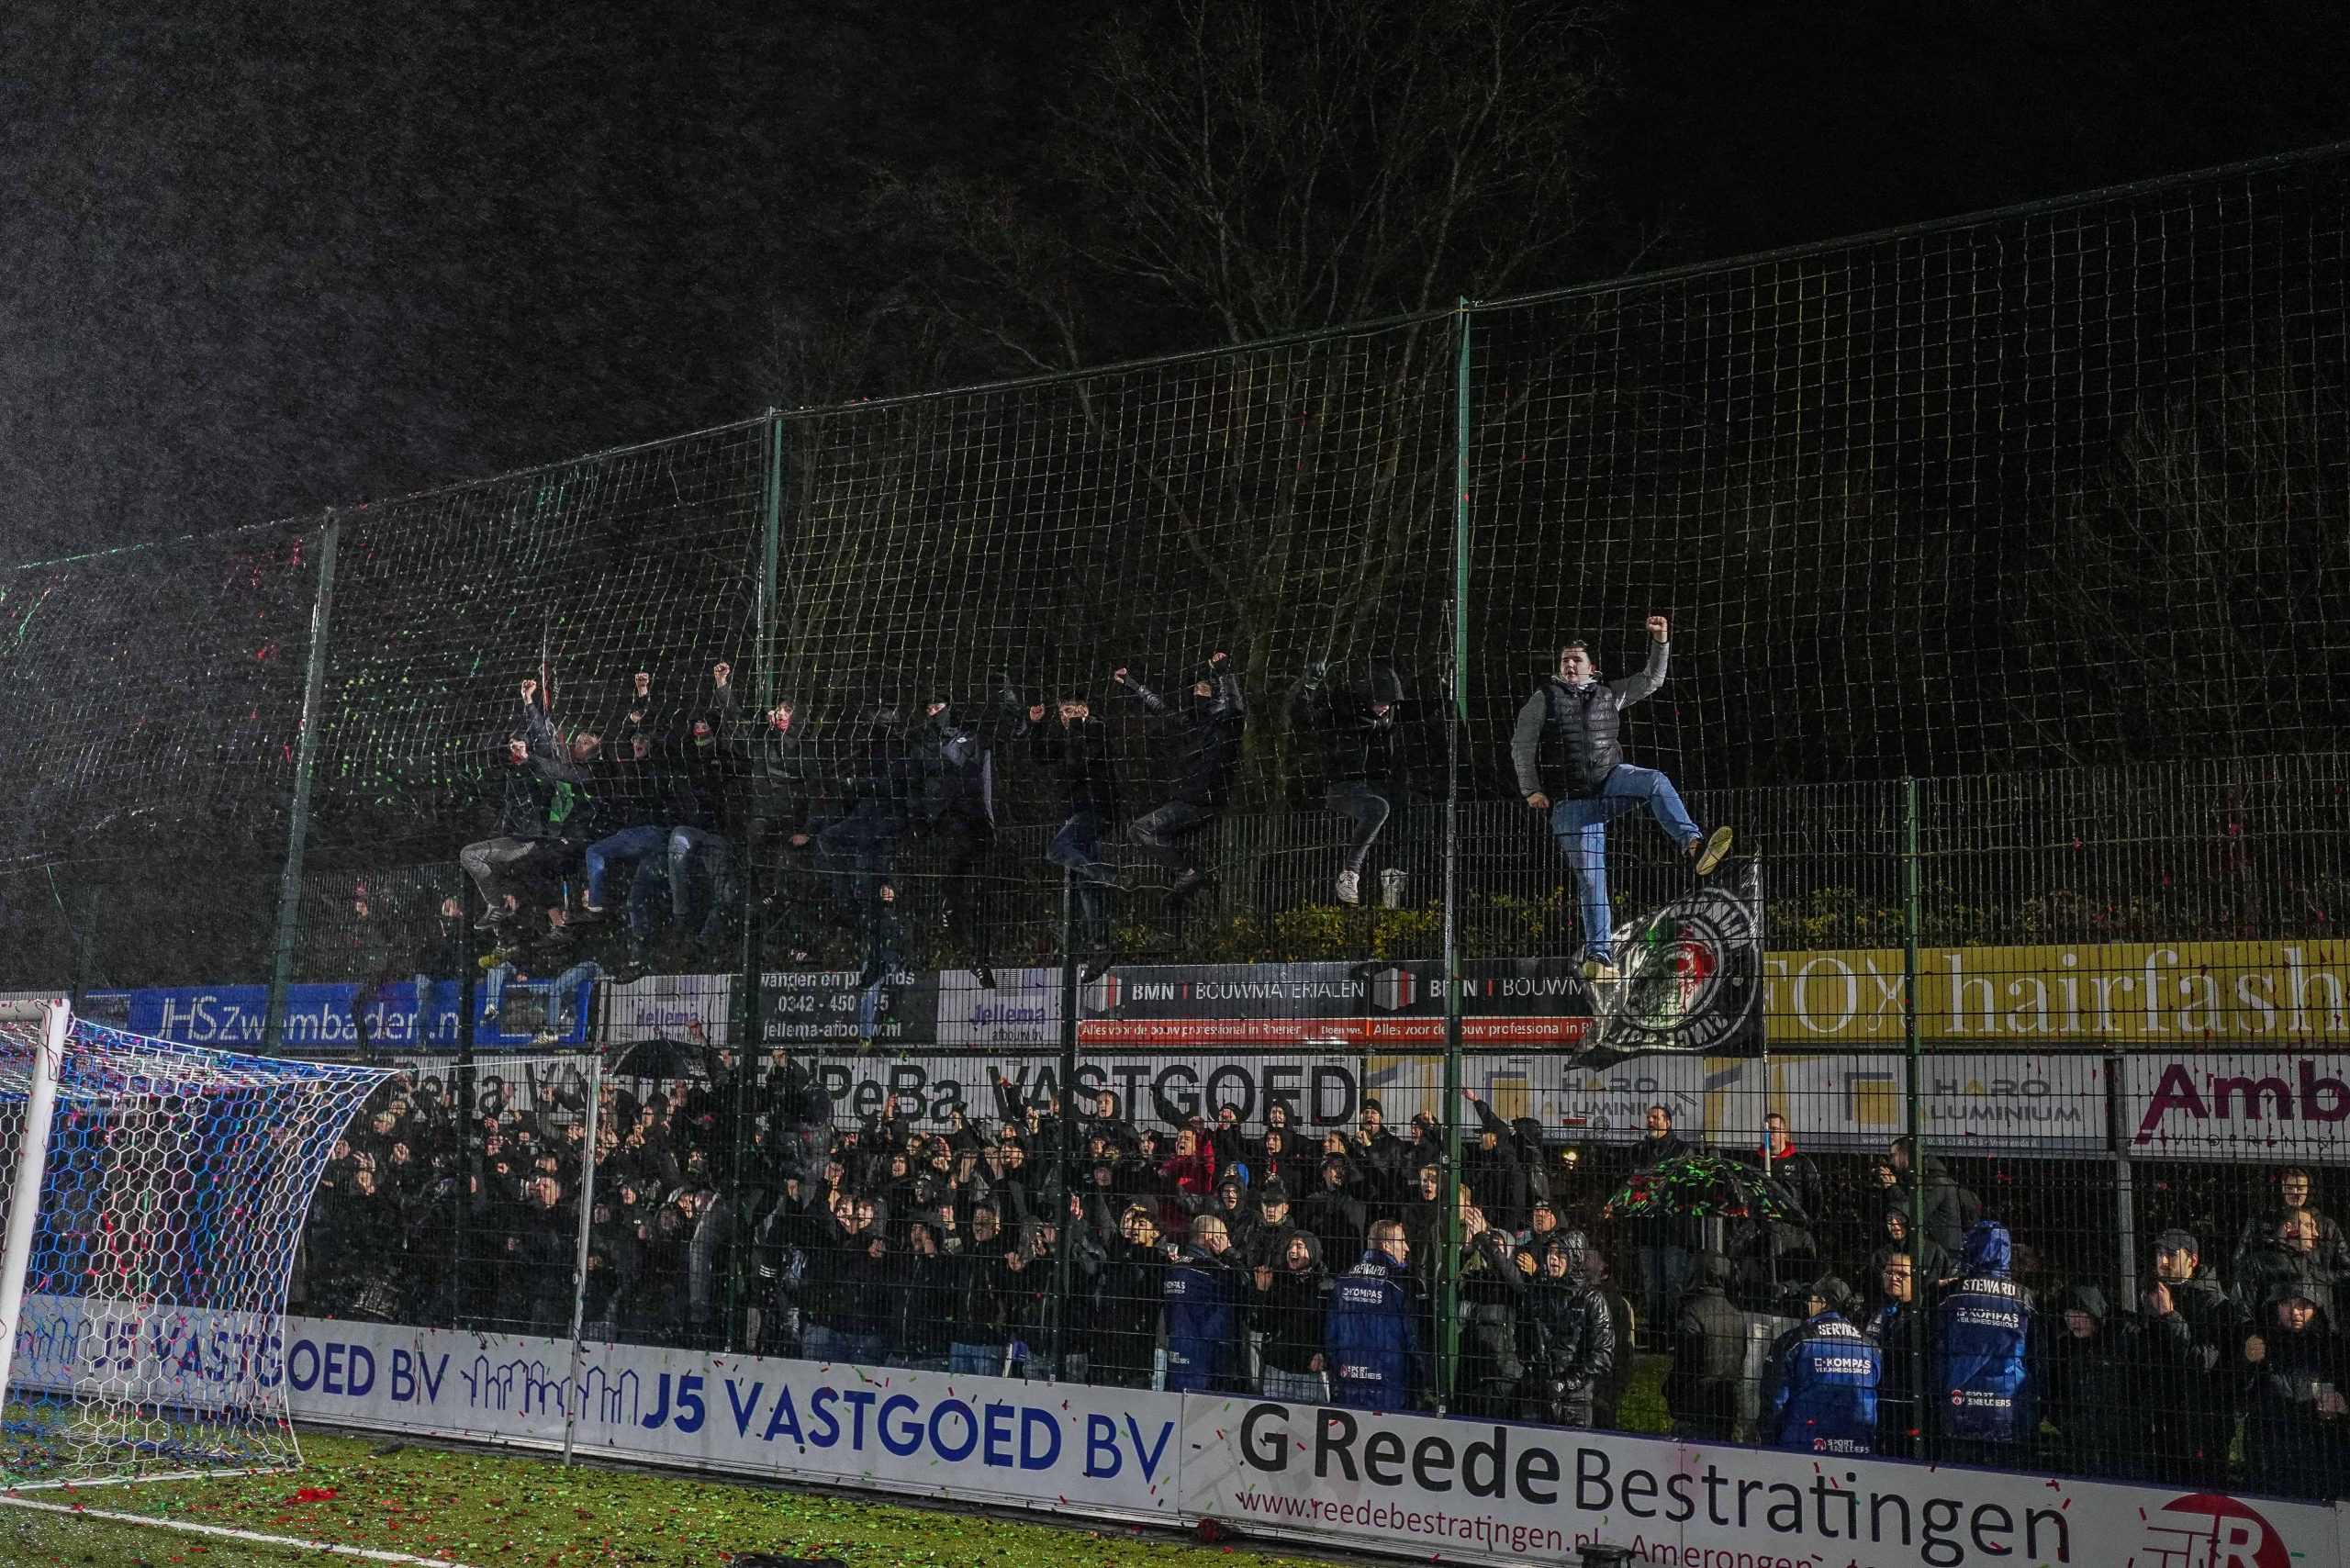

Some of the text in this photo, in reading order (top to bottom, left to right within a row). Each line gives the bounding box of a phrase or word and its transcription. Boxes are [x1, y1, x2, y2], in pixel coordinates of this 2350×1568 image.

[822, 973, 840, 987] en
[845, 970, 915, 991] plnds
[1132, 980, 1365, 1001] BMN BOUWMATERIALEN
[1430, 979, 1477, 998] BN
[778, 994, 814, 1013] 0342
[830, 994, 856, 1012] 450
[970, 1004, 1046, 1025] Jellema
[763, 1020, 901, 1041] jellema-afbow.nl
[1081, 1025, 1107, 1036] Alles
[1108, 1026, 1132, 1036] voor
[1134, 1025, 1147, 1036] de
[1248, 1024, 1259, 1035] in
[1373, 1025, 1401, 1036] Alles
[1404, 1025, 1430, 1036] voor
[1489, 1021, 1561, 1036] professional
[1566, 1021, 1578, 1034] in
[820, 1064, 968, 1125] PeBa
[987, 1063, 1357, 1129] VASTGOED
[1562, 1078, 1658, 1094] HARO
[1935, 1079, 2051, 1097] HARO
[1541, 1101, 1685, 1118] ALUMINIM
[1963, 1279, 2016, 1296] STEWARD
[93, 1320, 450, 1405] J5 VASTGOED BV
[1826, 1358, 1872, 1369] KOMPAS
[642, 1372, 1175, 1484] J5 VASTGOED BV
[1240, 1403, 1289, 1472] G
[1241, 1491, 1600, 1554] www.reedebestratingen.nl
